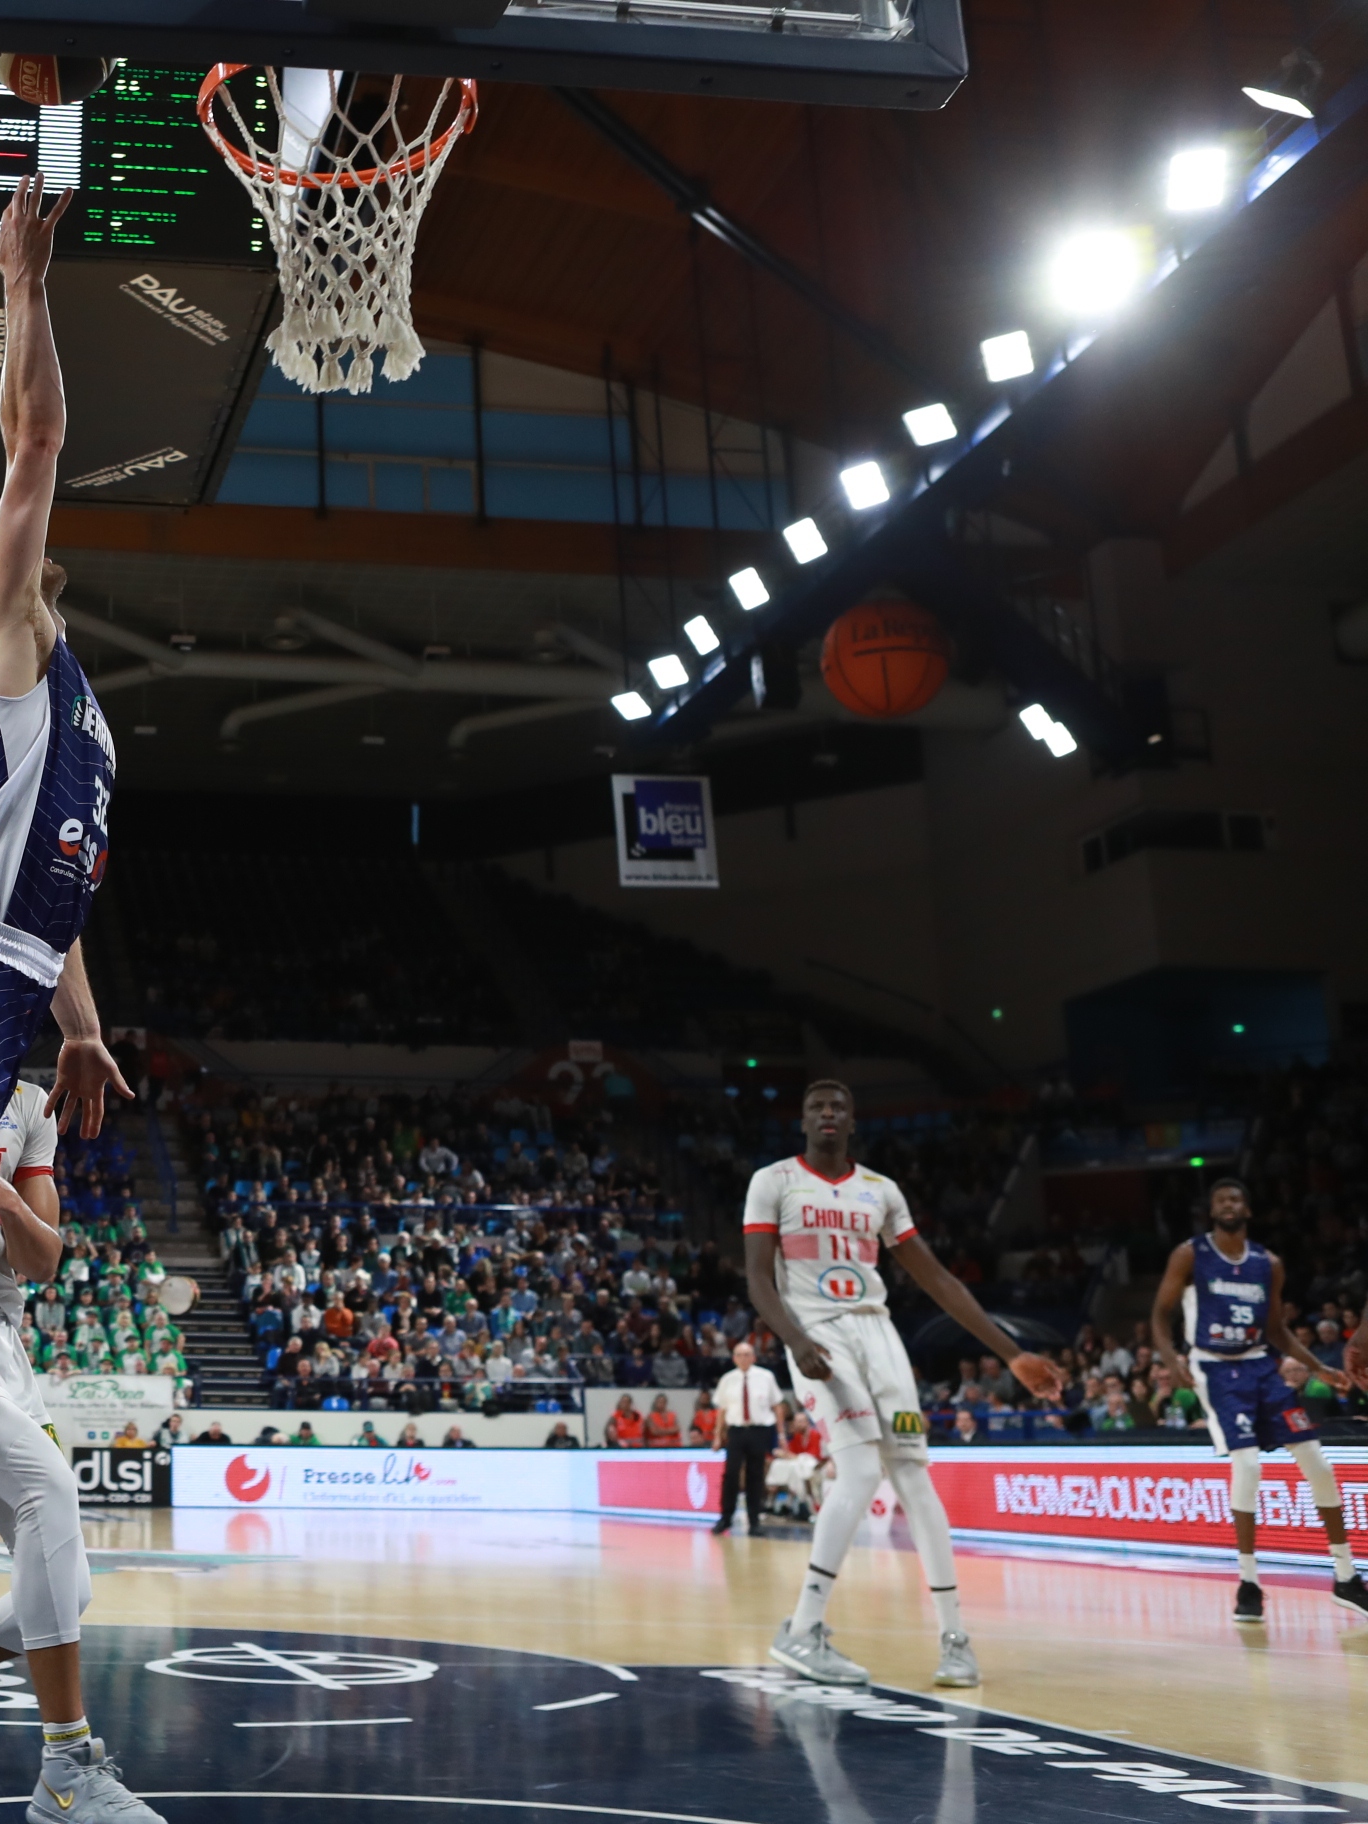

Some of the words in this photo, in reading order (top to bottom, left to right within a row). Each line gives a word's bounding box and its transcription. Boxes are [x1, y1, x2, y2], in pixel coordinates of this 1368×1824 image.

[129, 273, 197, 313] PAU
[123, 450, 189, 476] PAU
[638, 805, 703, 836] bleu
[802, 1205, 871, 1232] CHOLET
[829, 1234, 852, 1260] 11
[829, 1279, 854, 1299] U
[1229, 1304, 1254, 1325] 35
[73, 1450, 152, 1491] dlsi
[303, 1468, 376, 1485] Presse
[914, 1727, 1108, 1756] DE
[1044, 1761, 1350, 1814] PAU
